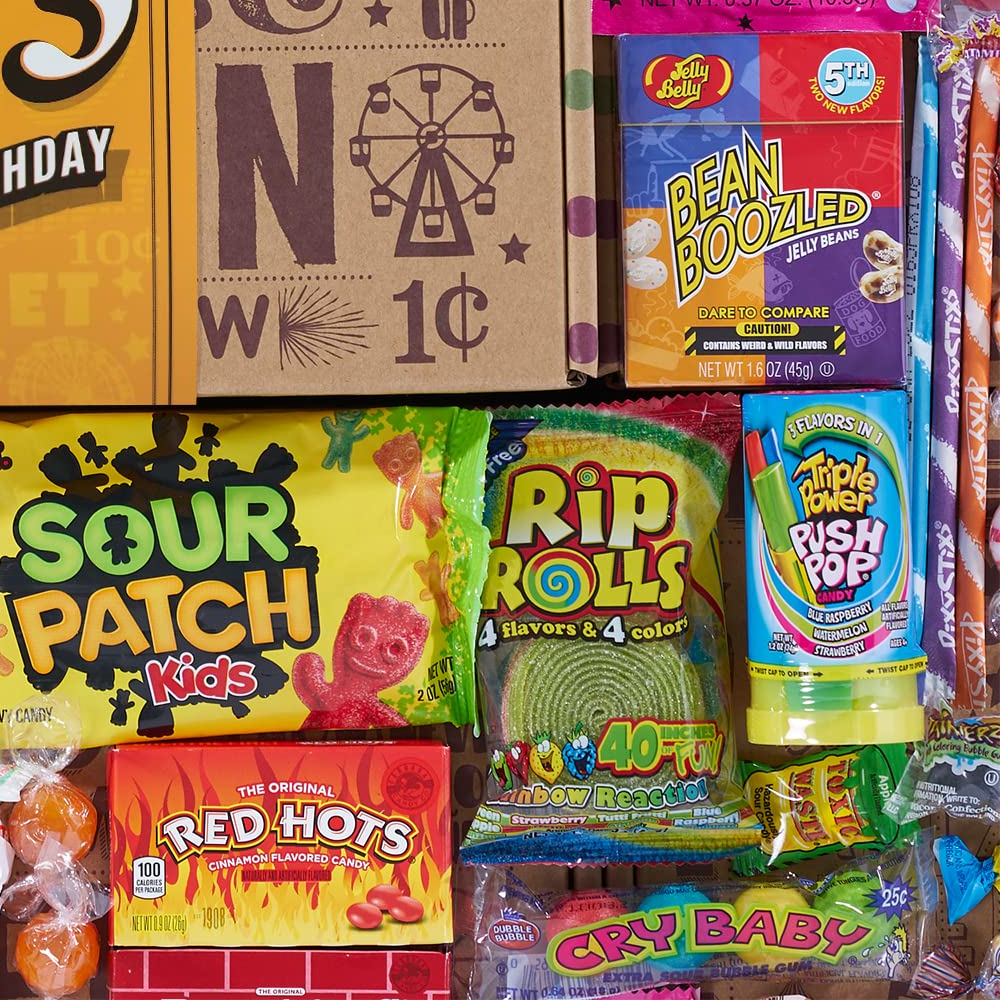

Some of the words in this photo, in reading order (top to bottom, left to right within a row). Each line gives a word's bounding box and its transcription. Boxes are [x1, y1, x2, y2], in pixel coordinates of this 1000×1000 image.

[666, 135, 781, 242] BEAN
[676, 191, 868, 302] BOOZLED
[786, 236, 818, 264] JELLY
[821, 228, 859, 248] BEANS
[393, 271, 489, 364] 1¢
[698, 307, 734, 319] DARE
[738, 307, 757, 319] TO
[760, 306, 829, 318] COMPARE
[744, 323, 791, 334] CAUTION!
[793, 451, 876, 491] Triple
[506, 467, 670, 549] Rip
[799, 484, 873, 519] Power
[20, 486, 293, 583] SOUR
[790, 519, 886, 555] PUSH
[804, 552, 879, 590] POP
[13, 568, 314, 675] PATCH
[478, 618, 497, 645] 4
[502, 620, 579, 641] flavors
[583, 621, 597, 638] &
[603, 616, 624, 643] 4
[813, 622, 868, 640] WATERMELON
[813, 641, 865, 657] STRAWBERRY
[145, 655, 257, 706] Kids
[15, 708, 53, 723] CANDY
[599, 722, 657, 770] 40
[238, 784, 265, 797] THE
[272, 782, 334, 798] ORIGINAL
[161, 806, 265, 854] RED
[280, 804, 413, 857] HOTS
[138, 862, 160, 878] 100
[209, 855, 268, 871] CINNAMON
[271, 853, 328, 864] FLAVORED
[331, 856, 370, 870] CANDY
[556, 914, 678, 971] CRY
[695, 909, 872, 956] BABY
